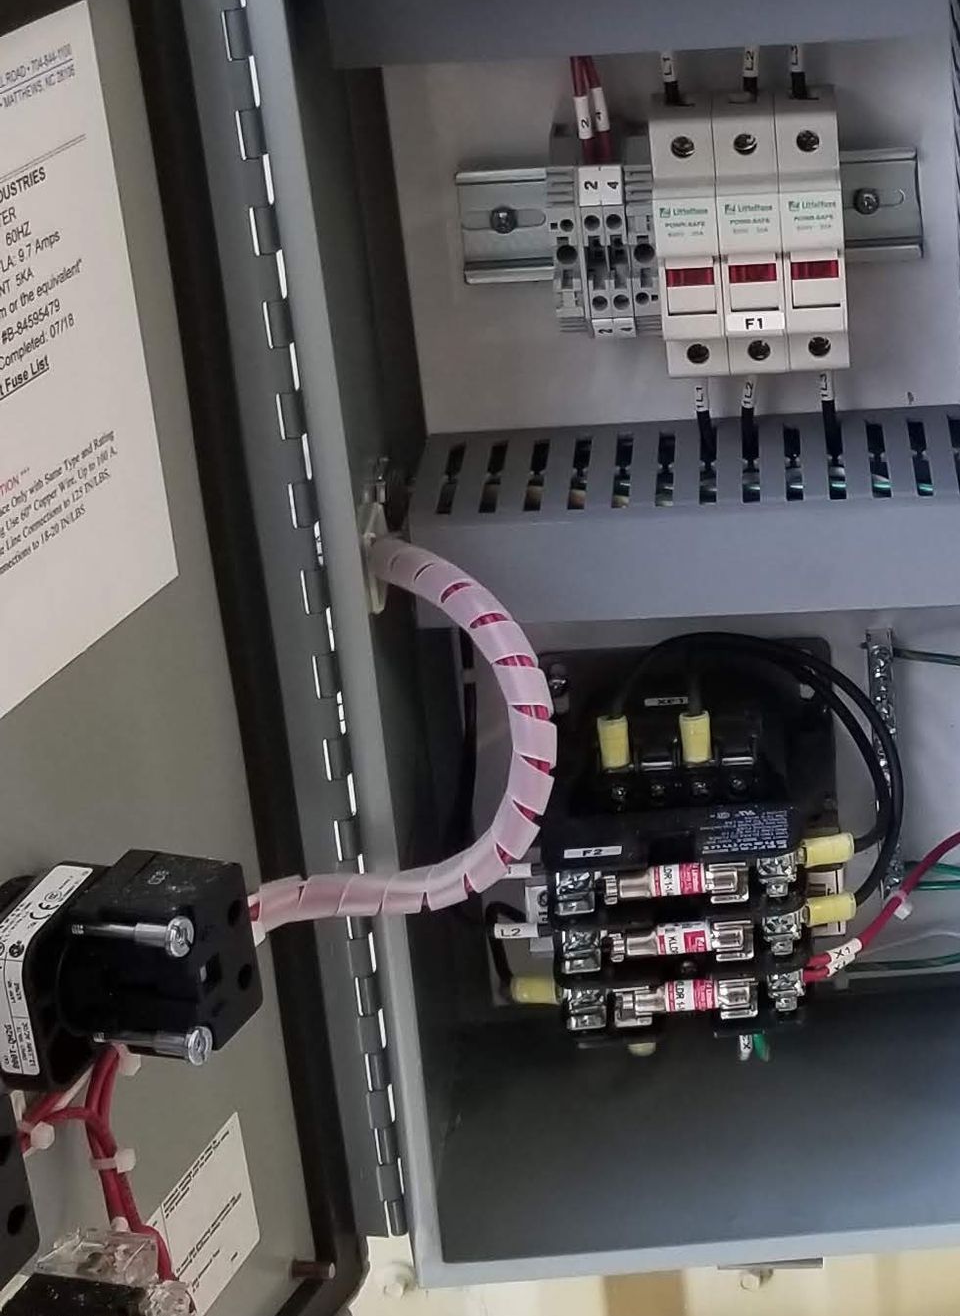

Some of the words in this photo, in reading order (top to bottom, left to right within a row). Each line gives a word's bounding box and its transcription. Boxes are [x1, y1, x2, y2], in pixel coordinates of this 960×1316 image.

[662, 56, 673, 76] L1
[745, 50, 755, 71] L2
[581, 118, 590, 129] 2
[584, 180, 599, 191] 2
[606, 181, 619, 190] 4
[5, 220, 32, 246] 60HZ
[35, 230, 61, 255] Amps
[15, 267, 35, 287] 5KA
[9, 299, 18, 314] or
[20, 290, 36, 307] the
[49, 312, 75, 339] 07/18
[744, 317, 763, 330] F1
[4, 370, 29, 392] Fuse
[30, 354, 50, 376] List
[695, 386, 705, 409] 1L1
[743, 381, 755, 406] 1L2
[11, 489, 28, 508] Only
[28, 478, 44, 495] with
[44, 466, 63, 485] Same
[63, 454, 80, 471] Type
[80, 443, 94, 460] and
[6, 516, 20, 531] Use
[33, 488, 58, 511] Copper
[77, 467, 88, 480] Up
[5, 534, 21, 551] Line
[22, 505, 63, 539] Connections
[63, 498, 71, 510] to
[582, 848, 604, 858] F2
[500, 928, 521, 937] L2
[834, 945, 851, 960] X1
